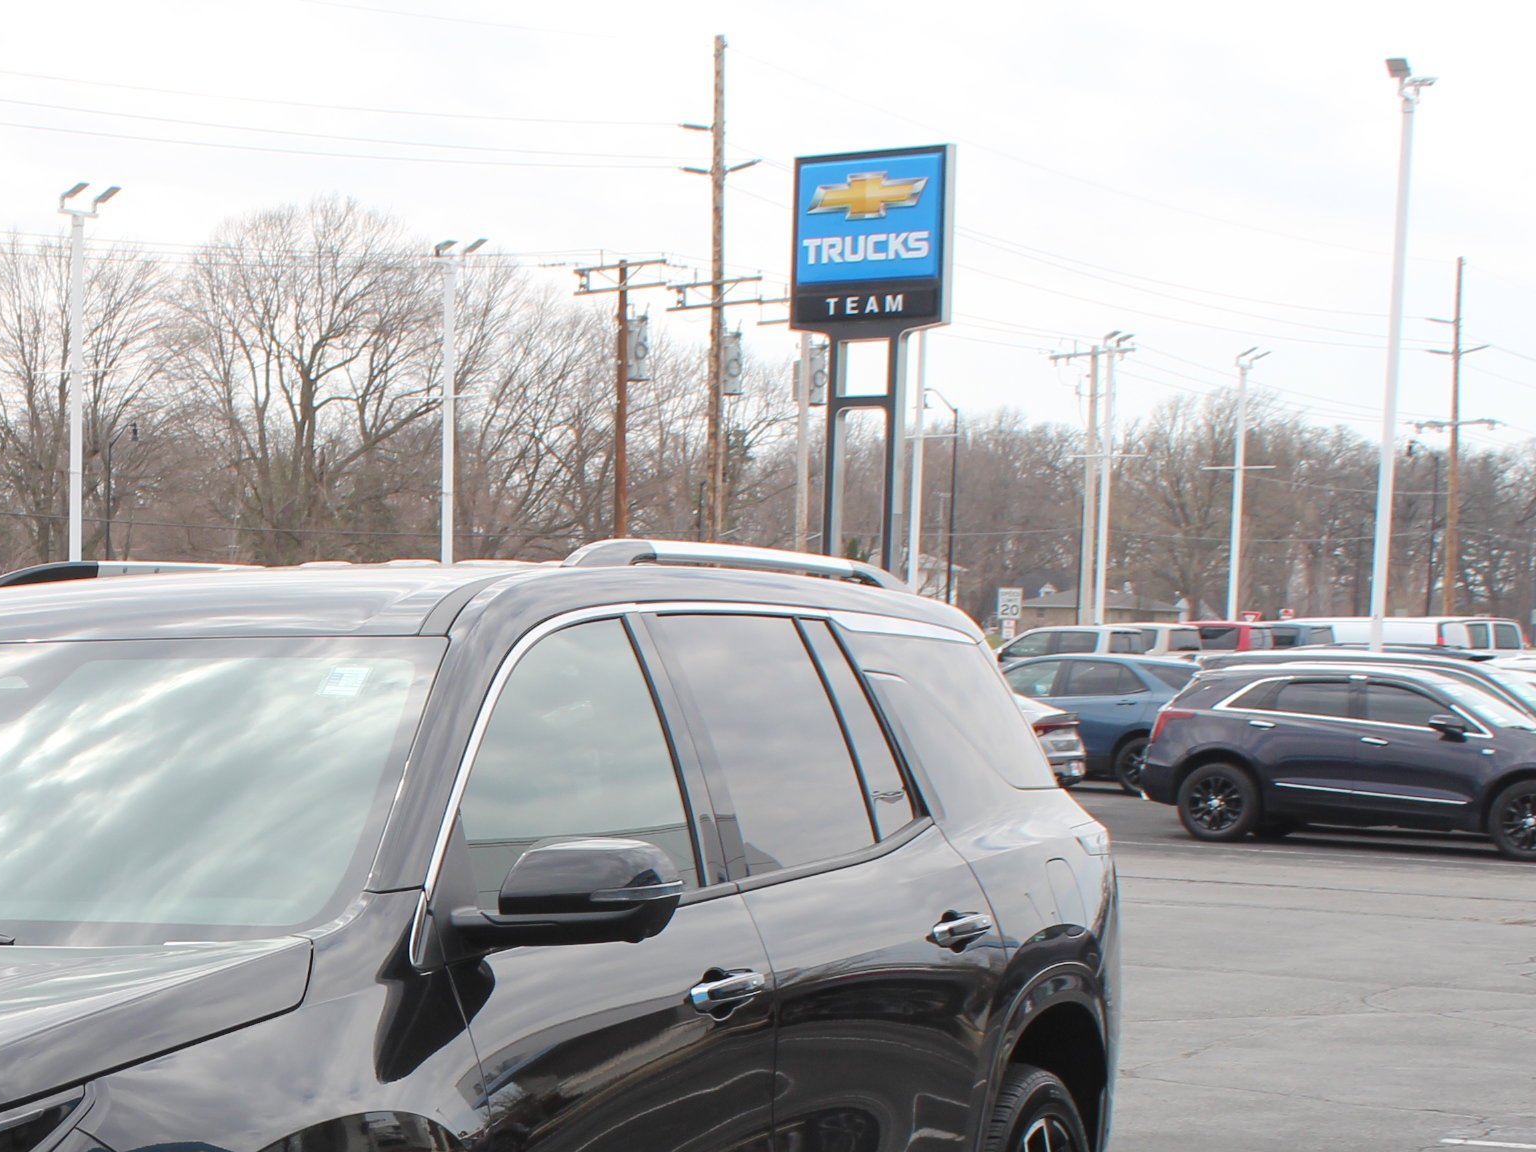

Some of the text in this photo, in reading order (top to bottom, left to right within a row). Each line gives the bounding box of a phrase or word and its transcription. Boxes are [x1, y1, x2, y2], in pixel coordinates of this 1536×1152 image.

[802, 231, 931, 265] TRUCKS
[826, 294, 904, 316] TEAM
[1001, 603, 1019, 616] 20
